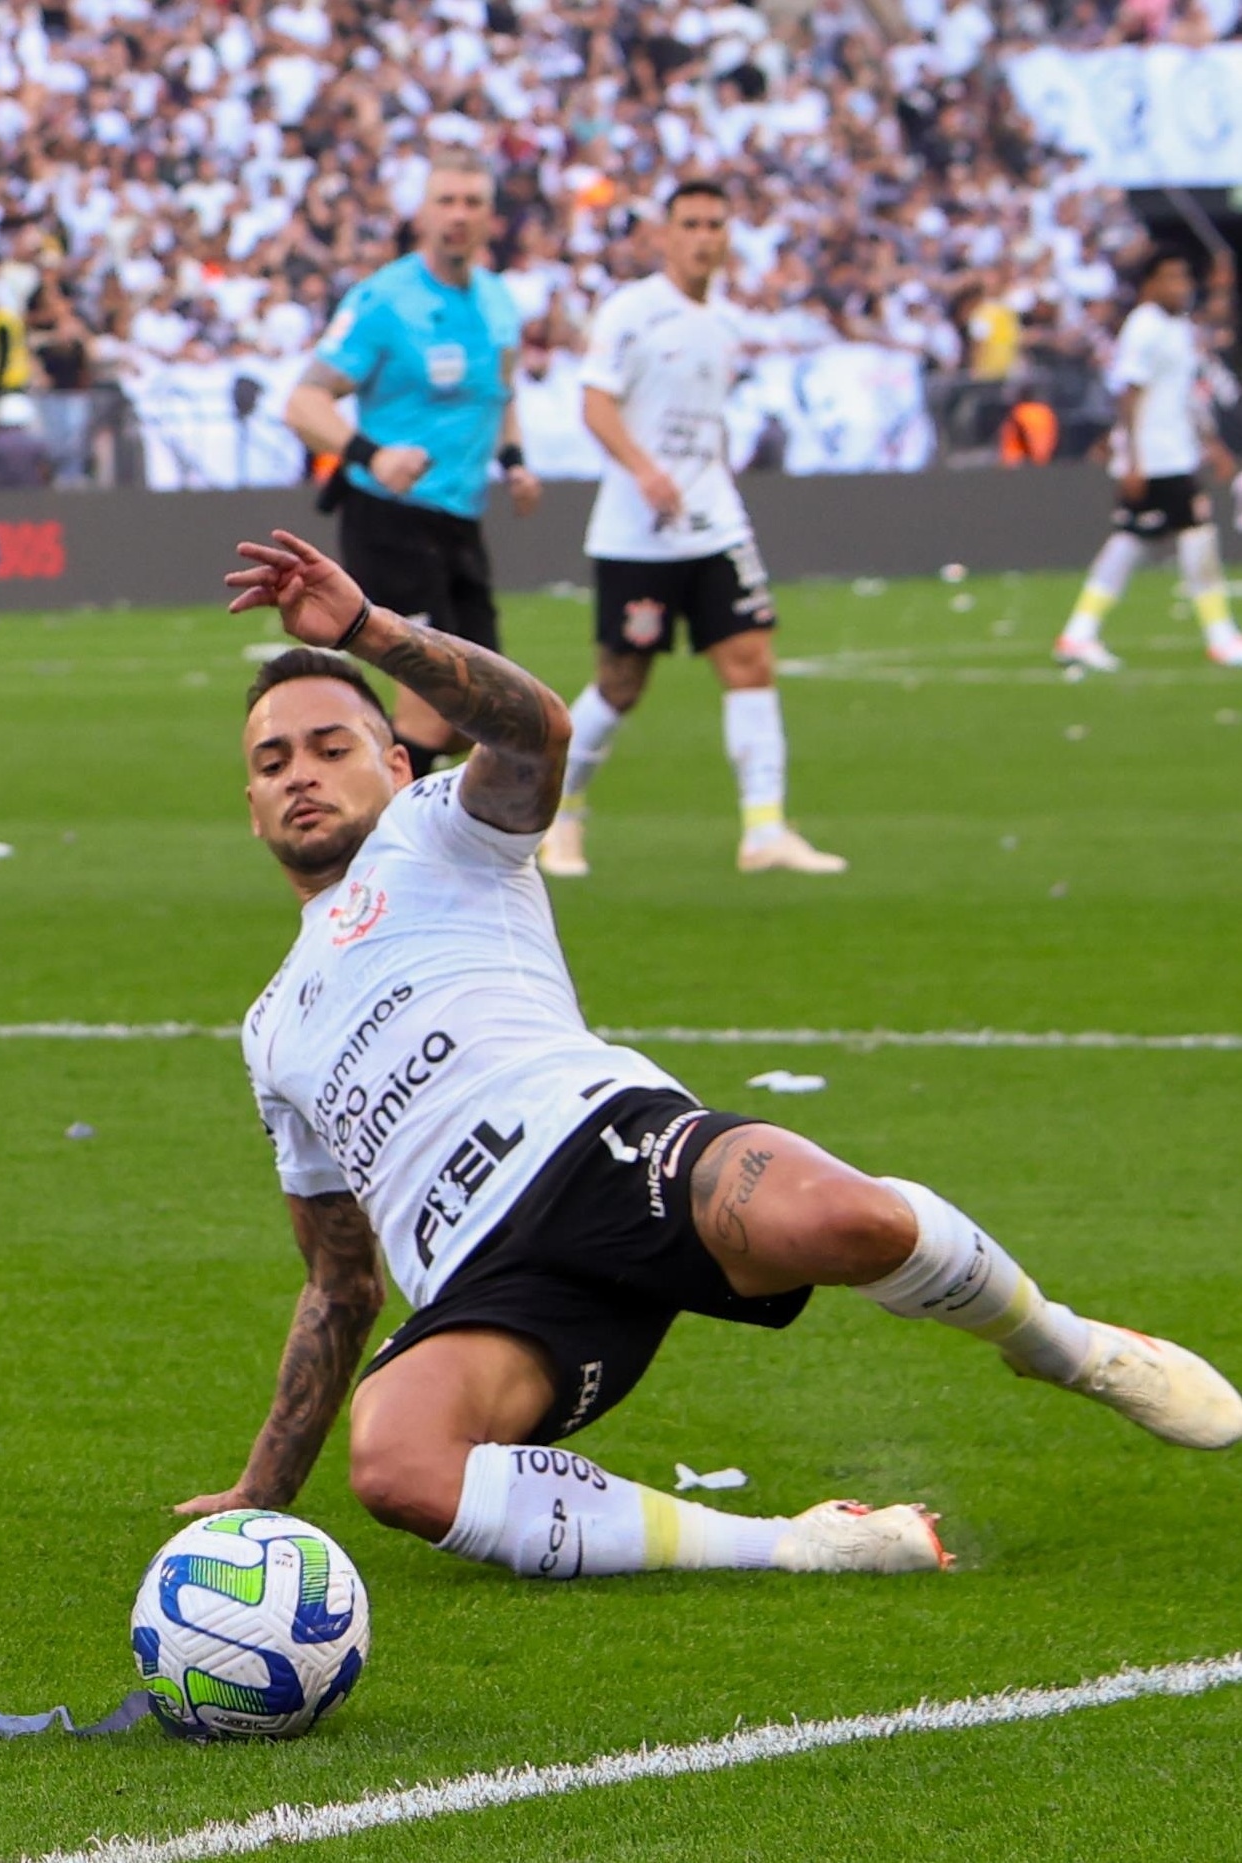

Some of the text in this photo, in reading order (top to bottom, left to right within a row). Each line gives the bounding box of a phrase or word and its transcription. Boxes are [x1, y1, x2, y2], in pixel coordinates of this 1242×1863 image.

[414, 1119, 527, 1270] FIEL
[715, 1148, 774, 1254] Faith
[510, 1449, 608, 1492] TODOS
